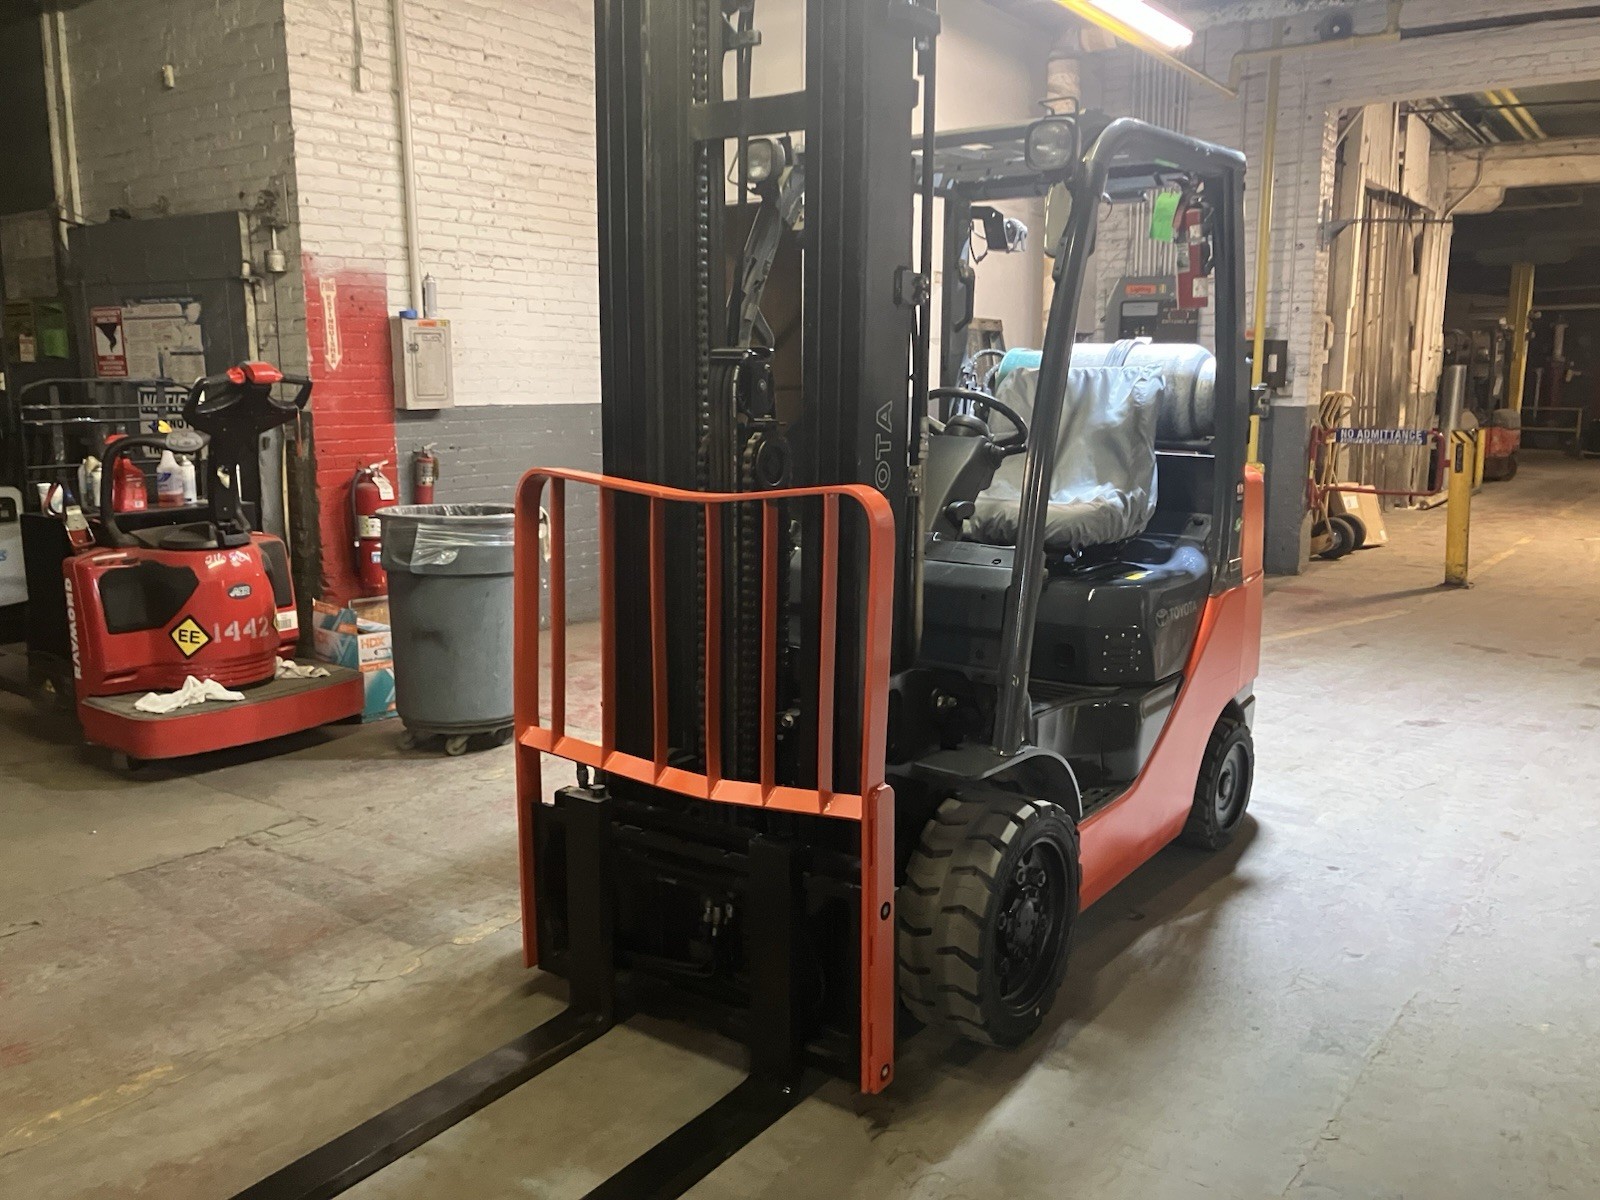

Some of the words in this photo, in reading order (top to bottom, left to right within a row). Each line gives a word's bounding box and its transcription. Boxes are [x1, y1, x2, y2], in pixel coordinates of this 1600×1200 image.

[1340, 428, 1355, 440] NO
[1356, 428, 1422, 440] ADMITTANCE
[1169, 600, 1199, 620] TOYOTA
[64, 577, 82, 680] RAYMOND
[178, 629, 201, 645] EE
[213, 616, 269, 644] 1442
[361, 636, 387, 650] HDX
